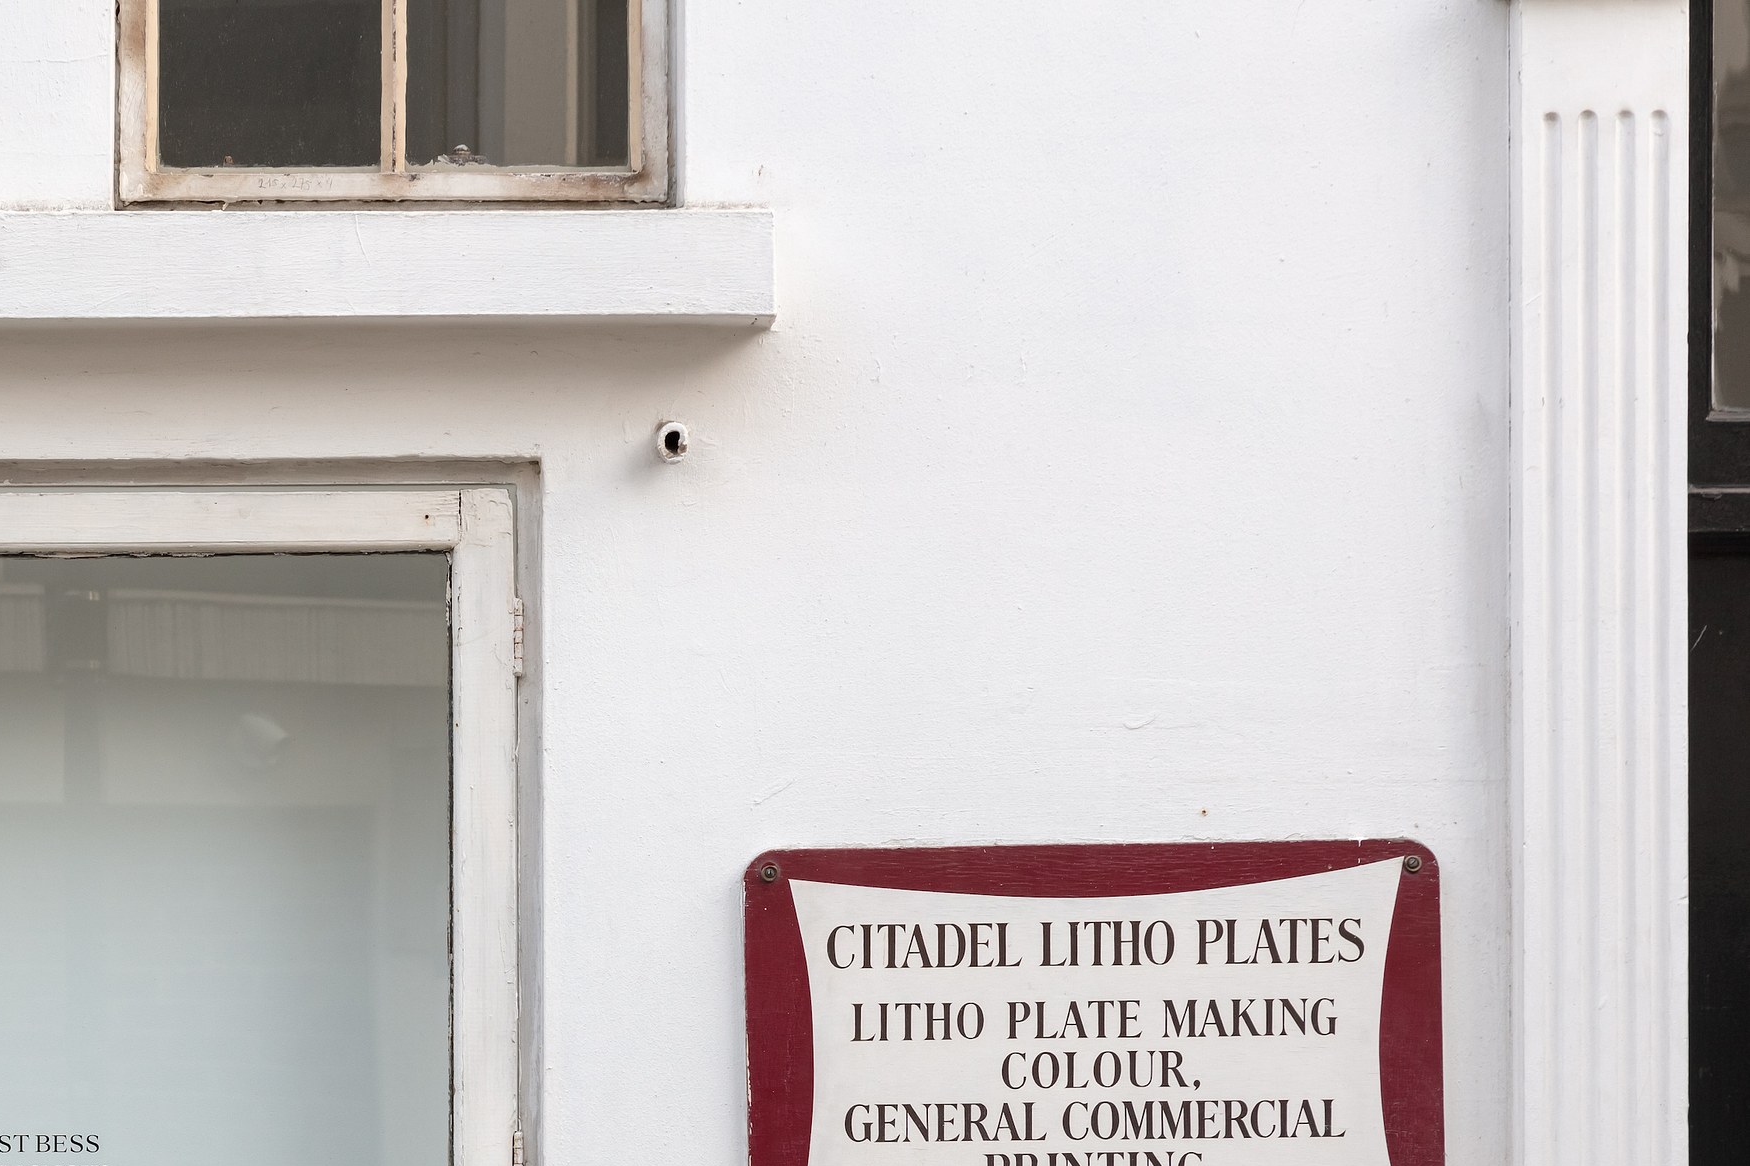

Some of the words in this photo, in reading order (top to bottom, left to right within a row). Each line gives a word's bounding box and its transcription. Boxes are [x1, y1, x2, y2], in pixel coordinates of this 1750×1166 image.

[827, 923, 1023, 969] CITADEL
[1039, 920, 1174, 966] LITHO
[1196, 918, 1365, 965] PLATES
[851, 1002, 985, 1042] LITHO
[1007, 1000, 1143, 1039] PLATE
[1162, 998, 1338, 1038] MAKING
[1002, 1050, 1201, 1090] COLOUR,
[845, 1102, 1048, 1142] GENERAL
[1063, 1099, 1347, 1140] COMMERCIAL
[35, 1134, 100, 1153] BESS
